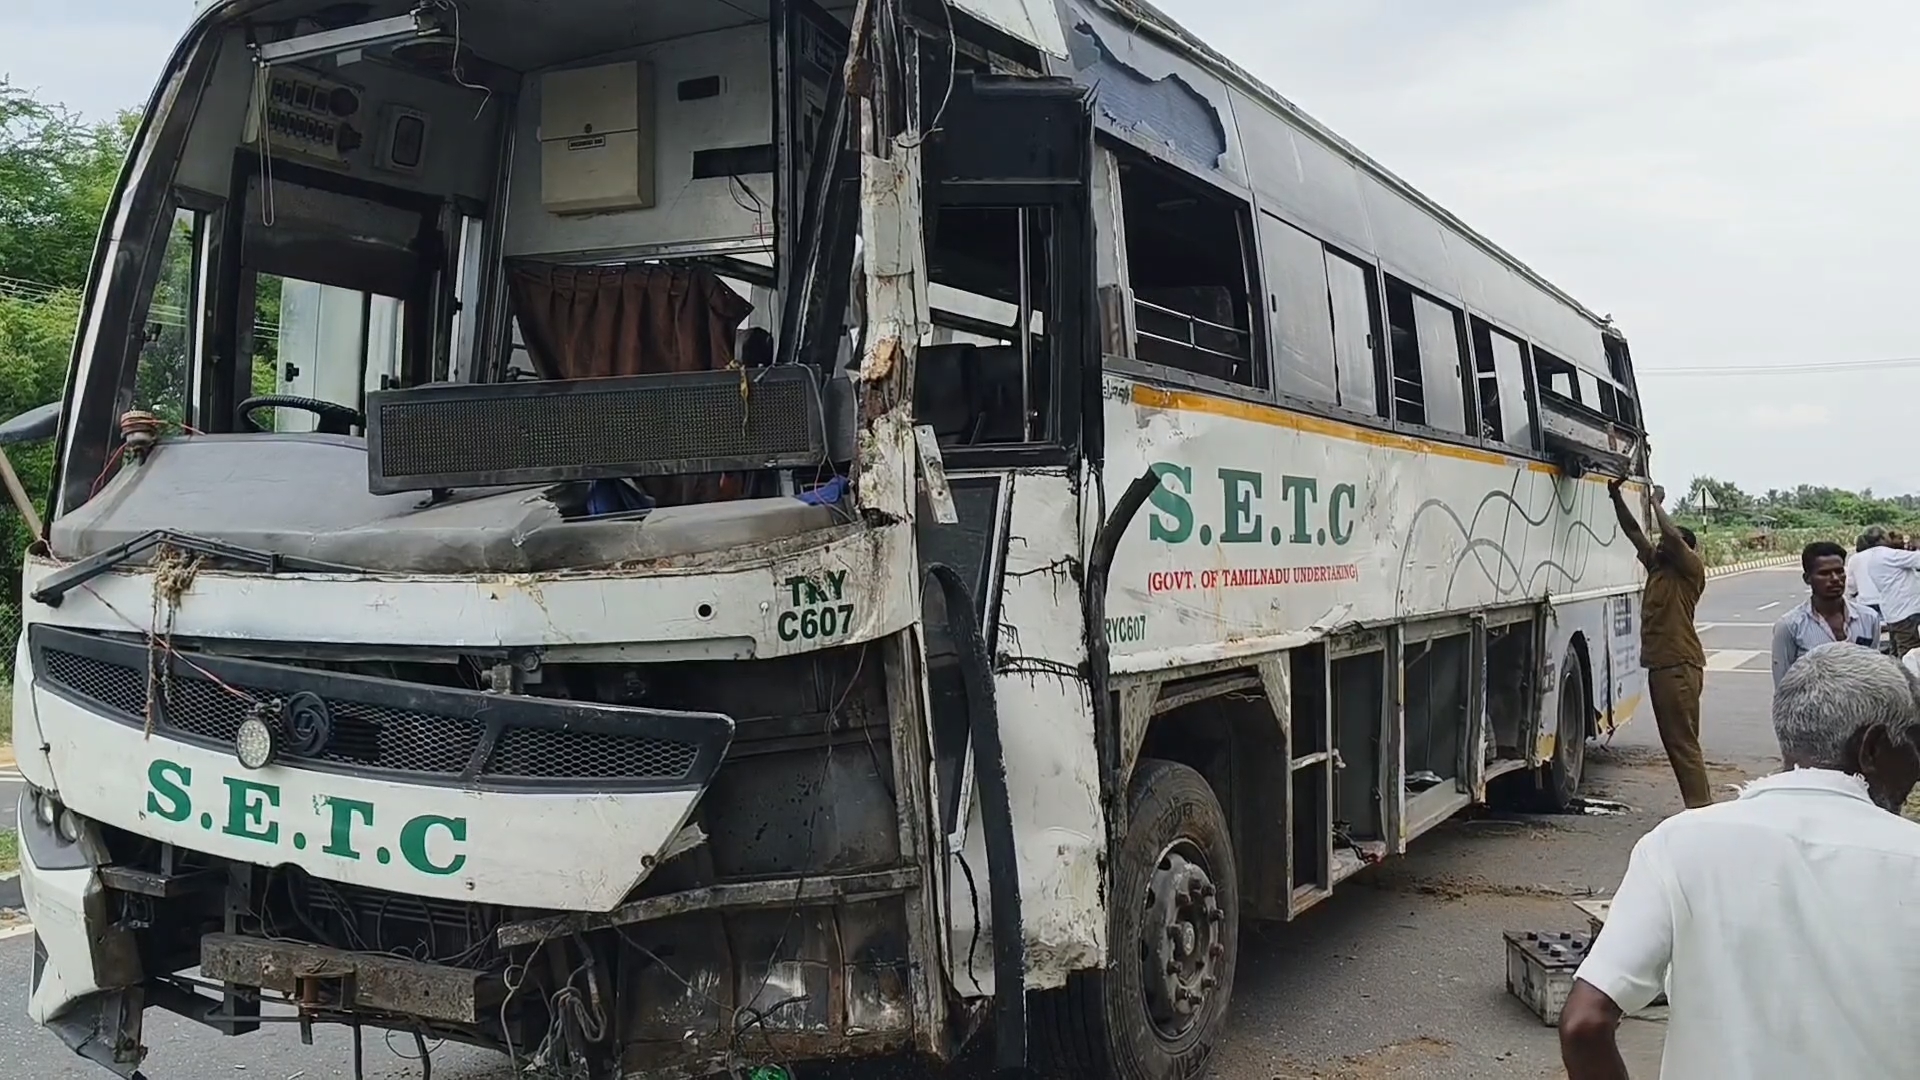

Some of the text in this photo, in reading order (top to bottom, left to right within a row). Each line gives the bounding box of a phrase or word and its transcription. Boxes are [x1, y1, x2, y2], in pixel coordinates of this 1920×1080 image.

[1149, 461, 1356, 546] S.E.T.C
[785, 569, 847, 607] TRY
[1201, 570, 1219, 588] OF
[1221, 567, 1290, 587] TAMILNADU
[777, 603, 854, 642] C607
[1104, 615, 1146, 644] RYC607
[147, 758, 468, 875] S.E.T.C
